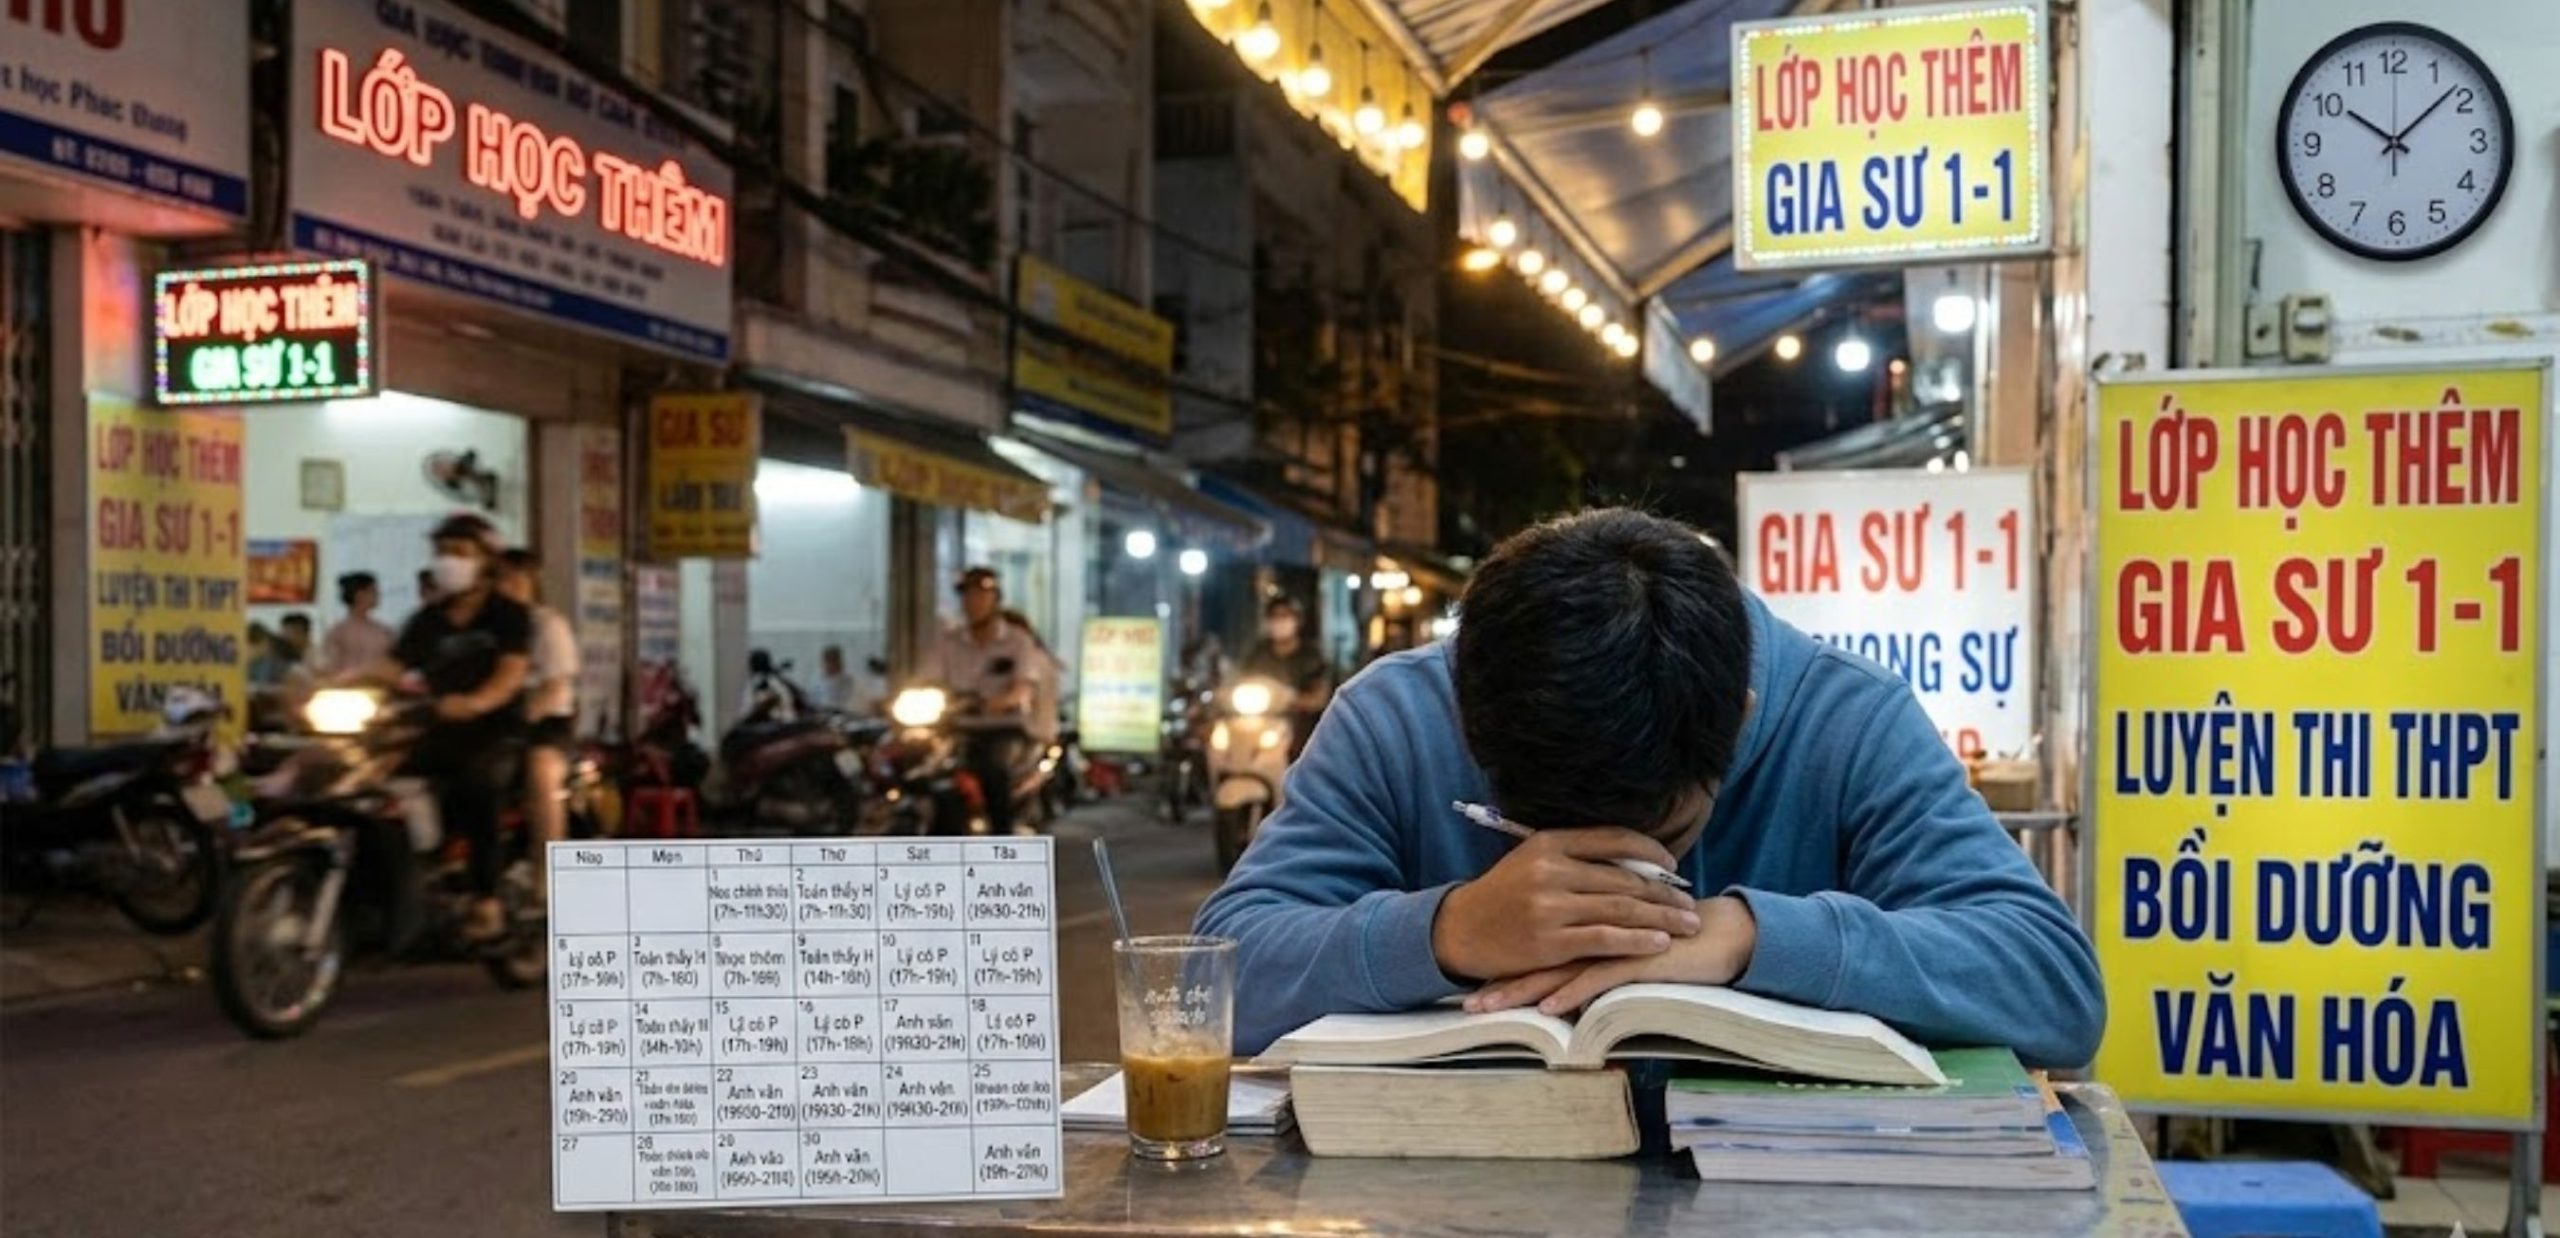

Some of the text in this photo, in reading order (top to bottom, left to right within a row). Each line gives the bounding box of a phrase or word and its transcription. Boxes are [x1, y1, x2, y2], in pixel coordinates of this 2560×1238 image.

[2378, 50, 2407, 73] 12
[2342, 61, 2364, 86] 11
[2427, 60, 2438, 84] 1
[1756, 28, 2023, 140] LỚP HỌC THÊM
[2313, 93, 2342, 116] 10
[2456, 88, 2473, 112] 2
[2303, 132, 2321, 157] 9
[2470, 128, 2487, 153] 3
[320, 48, 455, 168] LỚP
[466, 103, 588, 221] HỌC
[593, 158, 728, 267] THÊM
[2317, 173, 2335, 198] 8
[2456, 169, 2474, 194] 4
[1765, 147, 2015, 236] GIA SƯ 1-1
[2349, 202, 2365, 226] 7
[2428, 200, 2445, 224] 5
[2388, 210, 2405, 235] 6
[163, 282, 218, 339] LỚP
[219, 285, 280, 342] HỌC
[287, 340, 336, 386] 1-1
[2117, 387, 2522, 531] LỚP HỌC THÊM
[99, 497, 239, 558] GIA SƯ 1-1
[1759, 501, 2019, 594] GIA SƯ 1-1
[2117, 547, 2522, 657] GIA SƯ 1-1
[1959, 624, 2019, 709] SỰ
[2116, 690, 2521, 817] LUYỆN THI THPT
[712, 868, 719, 882] 1
[795, 867, 805, 881] 2
[879, 867, 889, 881] 3
[966, 866, 976, 879] 4
[862, 883, 873, 898] H
[936, 883, 947, 898] P
[976, 883, 1006, 898] Anh
[2122, 828, 2493, 950] BỒI DƯỠNG
[881, 934, 896, 947] 10
[969, 933, 981, 946] 11
[606, 949, 617, 965] P
[864, 950, 873, 964] H
[937, 948, 948, 962] P
[1023, 948, 1033, 962] P
[559, 1003, 574, 1018] 13
[634, 1002, 649, 1016] 14
[714, 1001, 729, 1015] 15
[884, 999, 898, 1012] 17
[971, 998, 987, 1012] 18
[607, 1020, 619, 1035] P
[768, 1015, 779, 1031] P
[854, 1014, 864, 1029] P
[896, 1014, 924, 1030] Anh
[1026, 1012, 1036, 1028] P
[2153, 971, 2469, 1089] VĂN HÓA
[716, 1069, 733, 1083] 22
[801, 1066, 818, 1080] 23
[886, 1066, 903, 1079] 24
[973, 1065, 990, 1078] 25
[569, 1088, 595, 1103] Anh
[727, 1084, 753, 1100] Anh
[812, 1083, 841, 1098] Anh
[899, 1081, 926, 1096] Anh
[561, 1138, 578, 1151] 27
[802, 1133, 821, 1146] 30
[814, 1150, 841, 1165] Anh
[984, 1144, 1013, 1160] Anh
